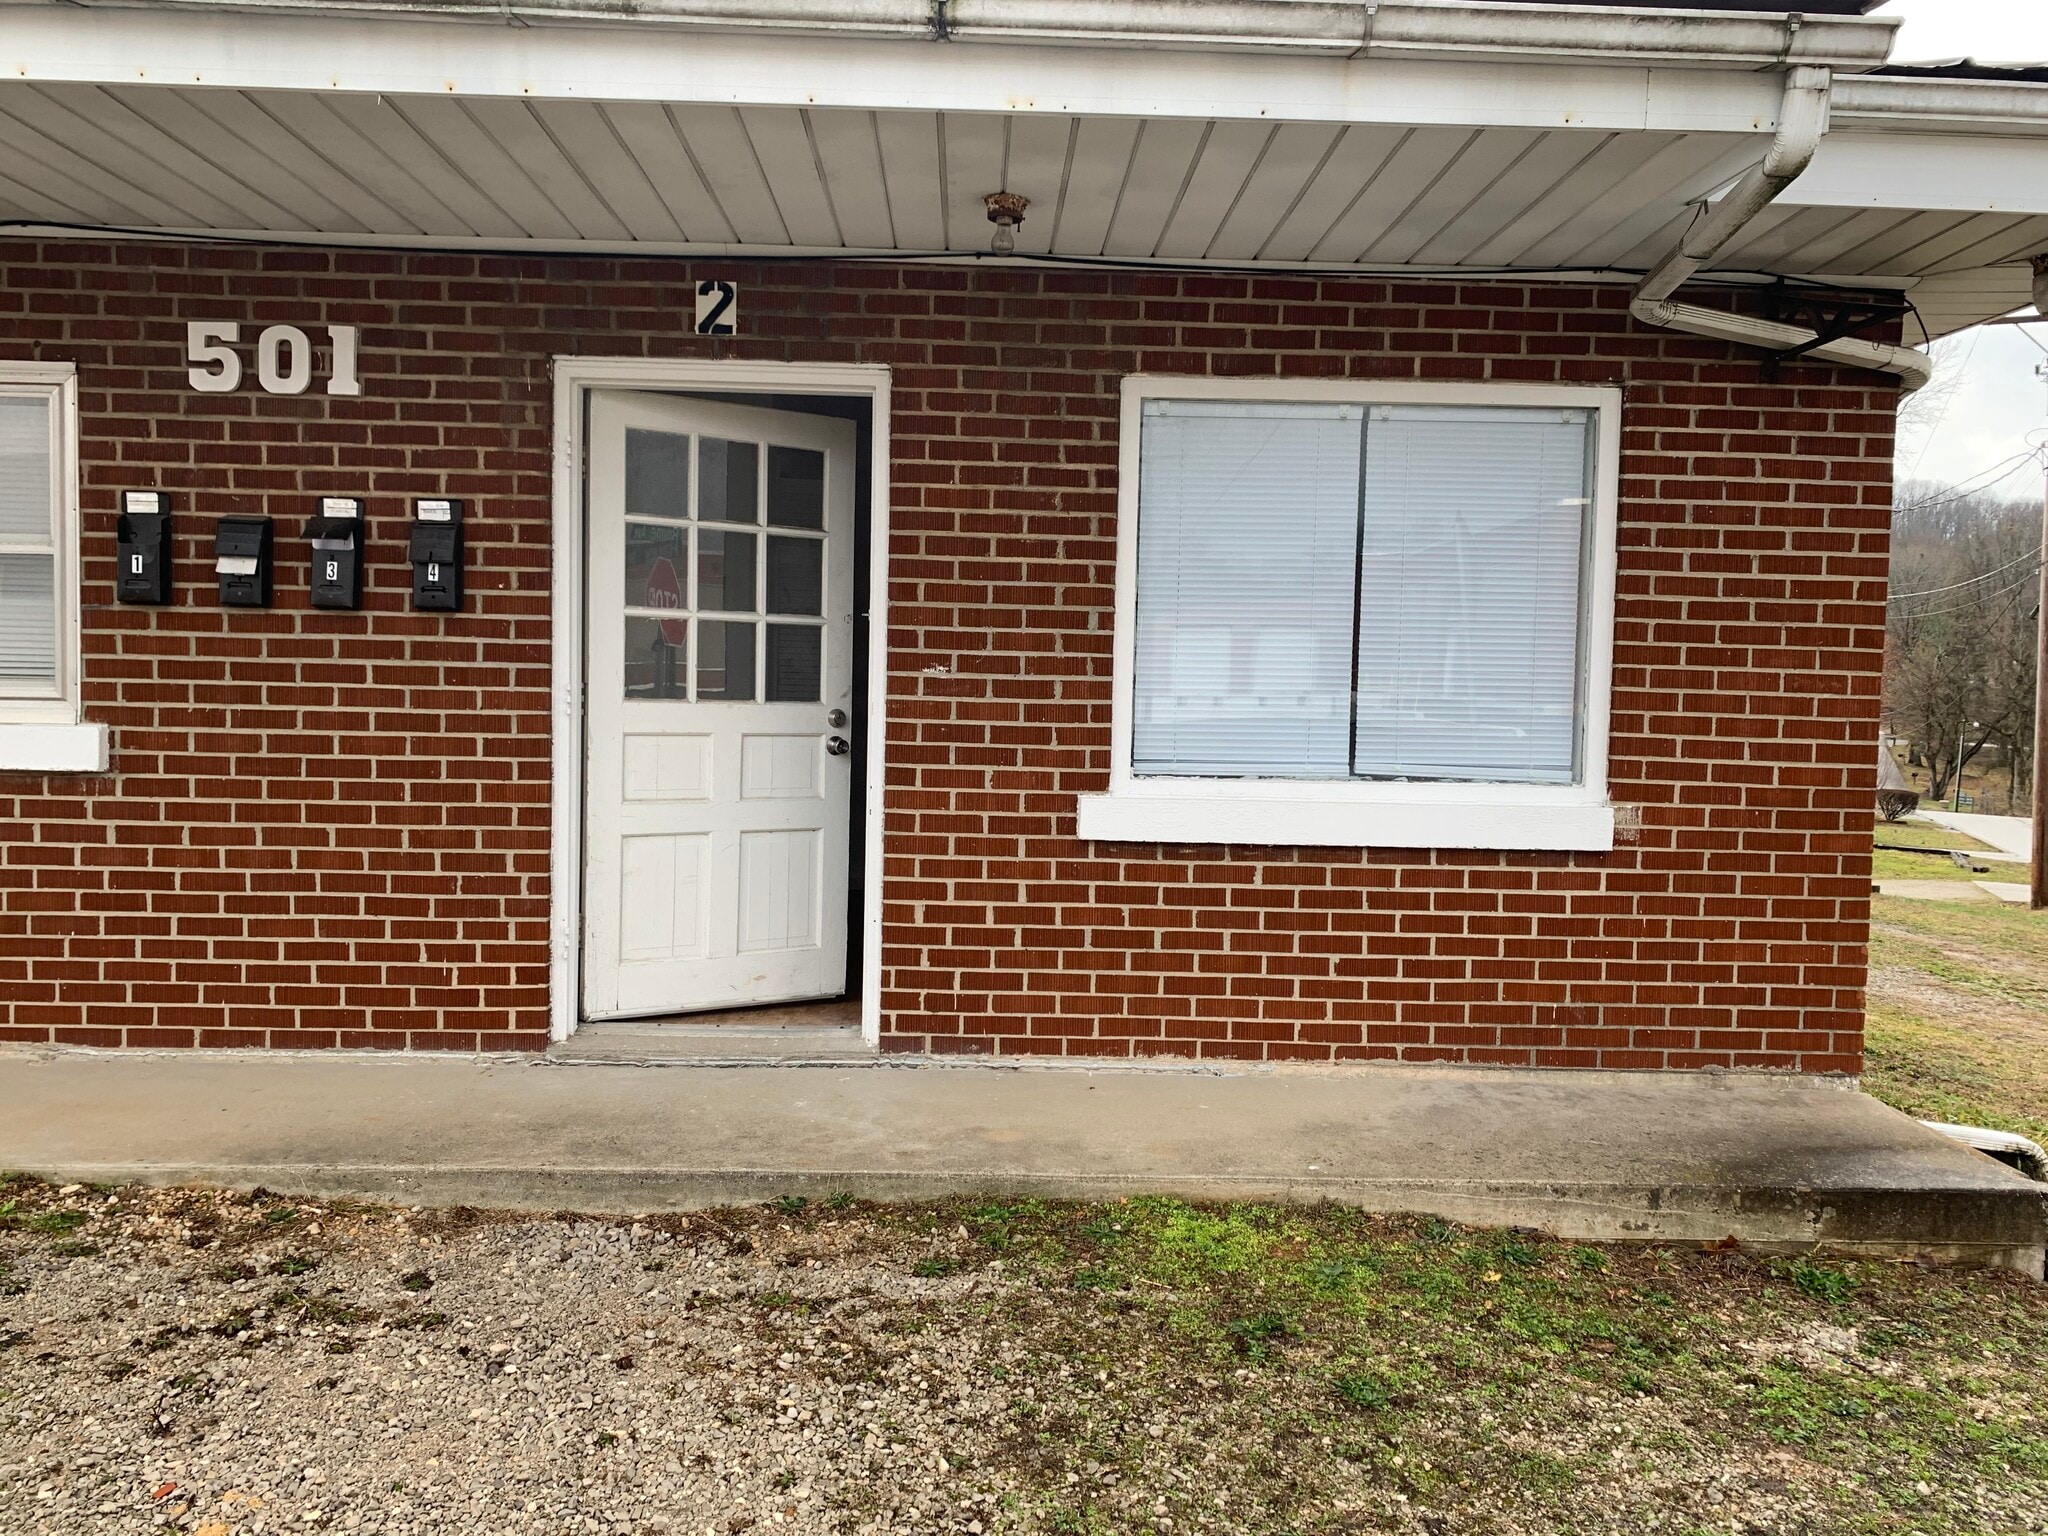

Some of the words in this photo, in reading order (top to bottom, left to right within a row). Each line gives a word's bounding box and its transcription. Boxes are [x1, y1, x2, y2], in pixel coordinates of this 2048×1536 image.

[698, 281, 734, 334] 2
[187, 321, 361, 396] 501
[134, 556, 140, 572] 1
[327, 563, 335, 578] 3
[429, 564, 437, 579] 4
